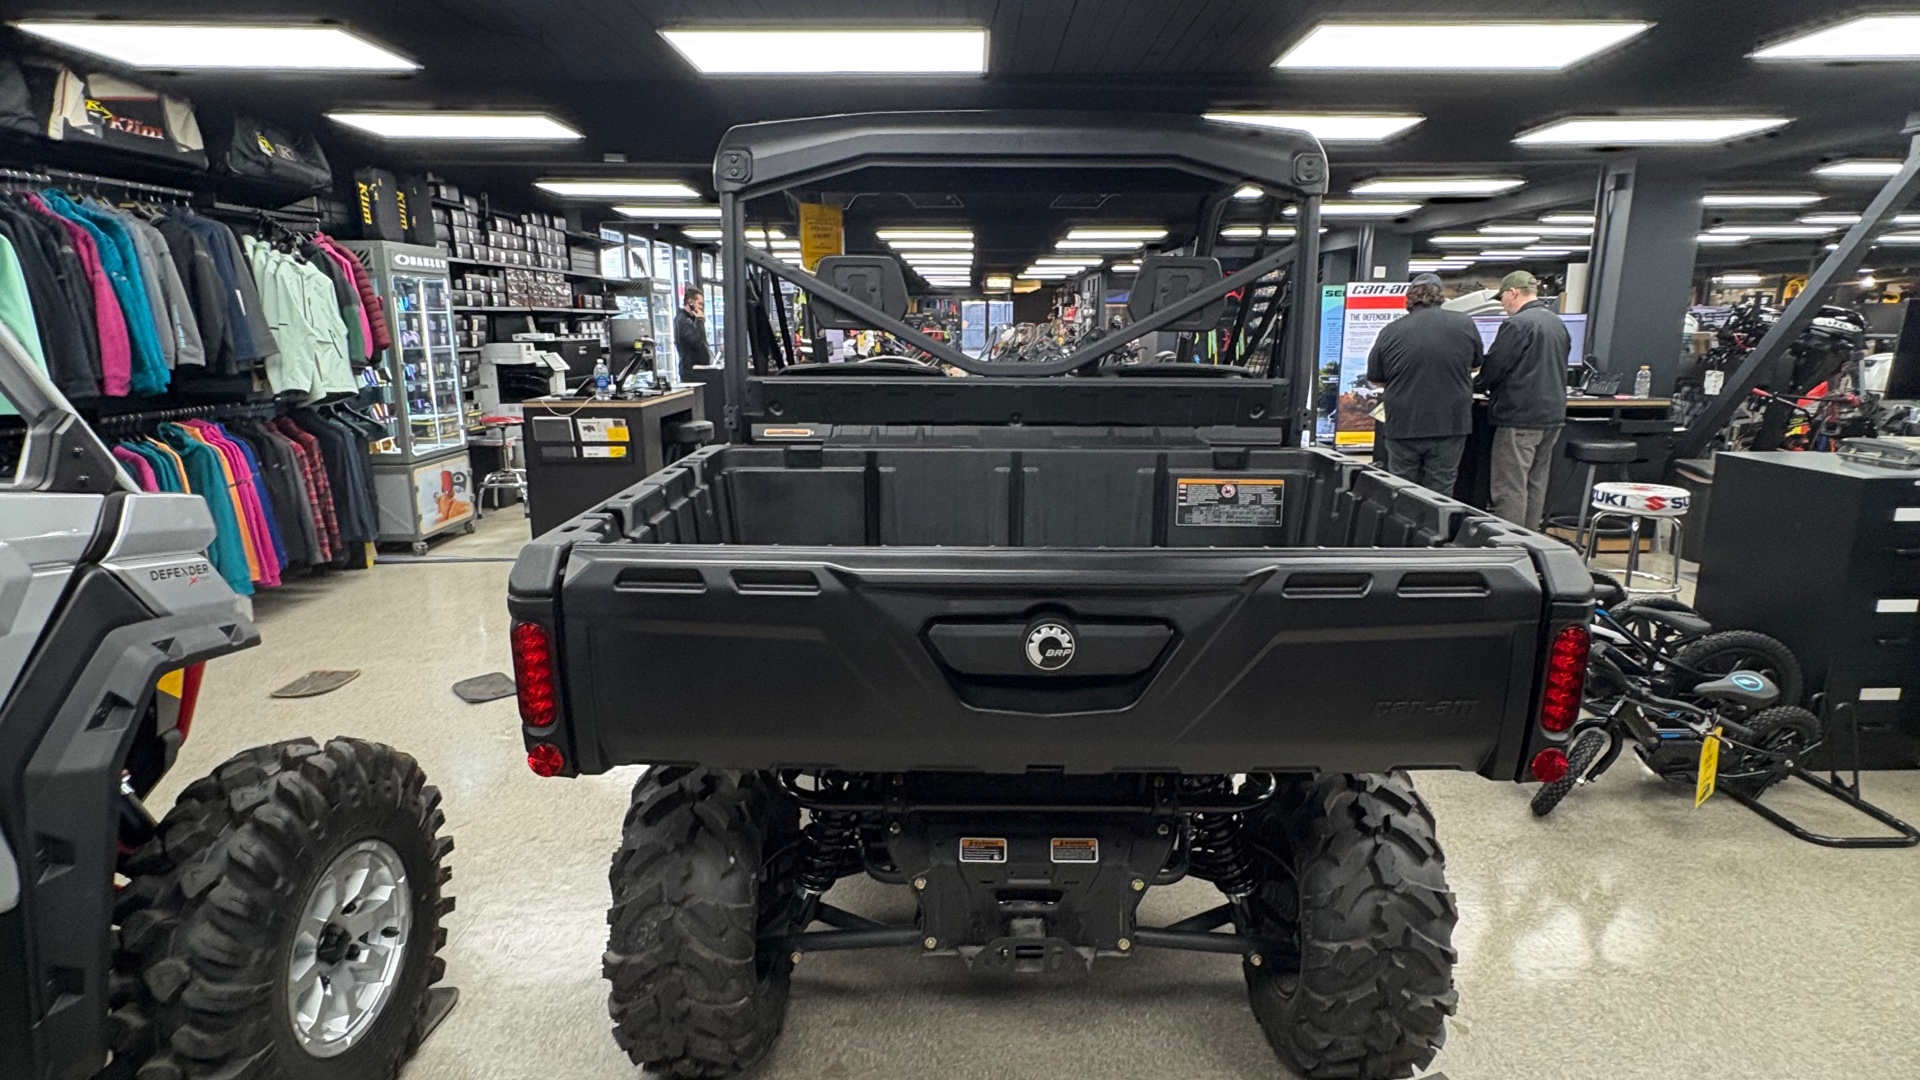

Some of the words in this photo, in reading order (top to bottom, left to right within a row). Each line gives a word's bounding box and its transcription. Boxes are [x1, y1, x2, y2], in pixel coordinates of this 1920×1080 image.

[394, 254, 447, 269] OAKLEY
[150, 564, 209, 581] DEFENDER
[1045, 649, 1072, 657] BRP
